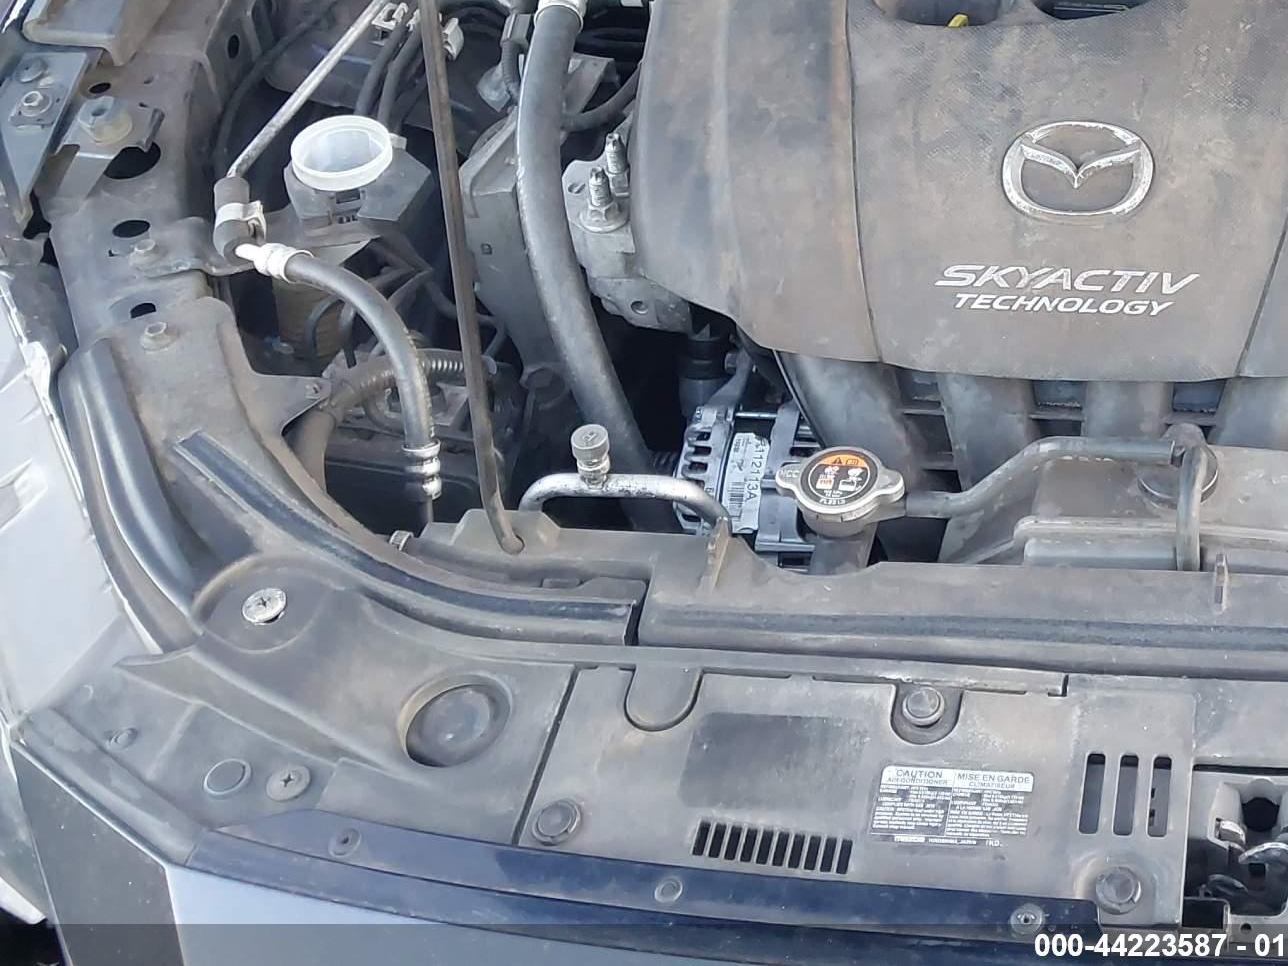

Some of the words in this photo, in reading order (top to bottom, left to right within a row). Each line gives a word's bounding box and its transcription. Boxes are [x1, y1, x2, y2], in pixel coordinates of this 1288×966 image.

[934, 265, 1200, 295] SKYACTIV
[954, 294, 1174, 316] TECHNOLOGY
[896, 769, 943, 779] CAUTION
[957, 773, 980, 781] MISE
[982, 774, 995, 782] EN
[997, 775, 1031, 784] GARDE
